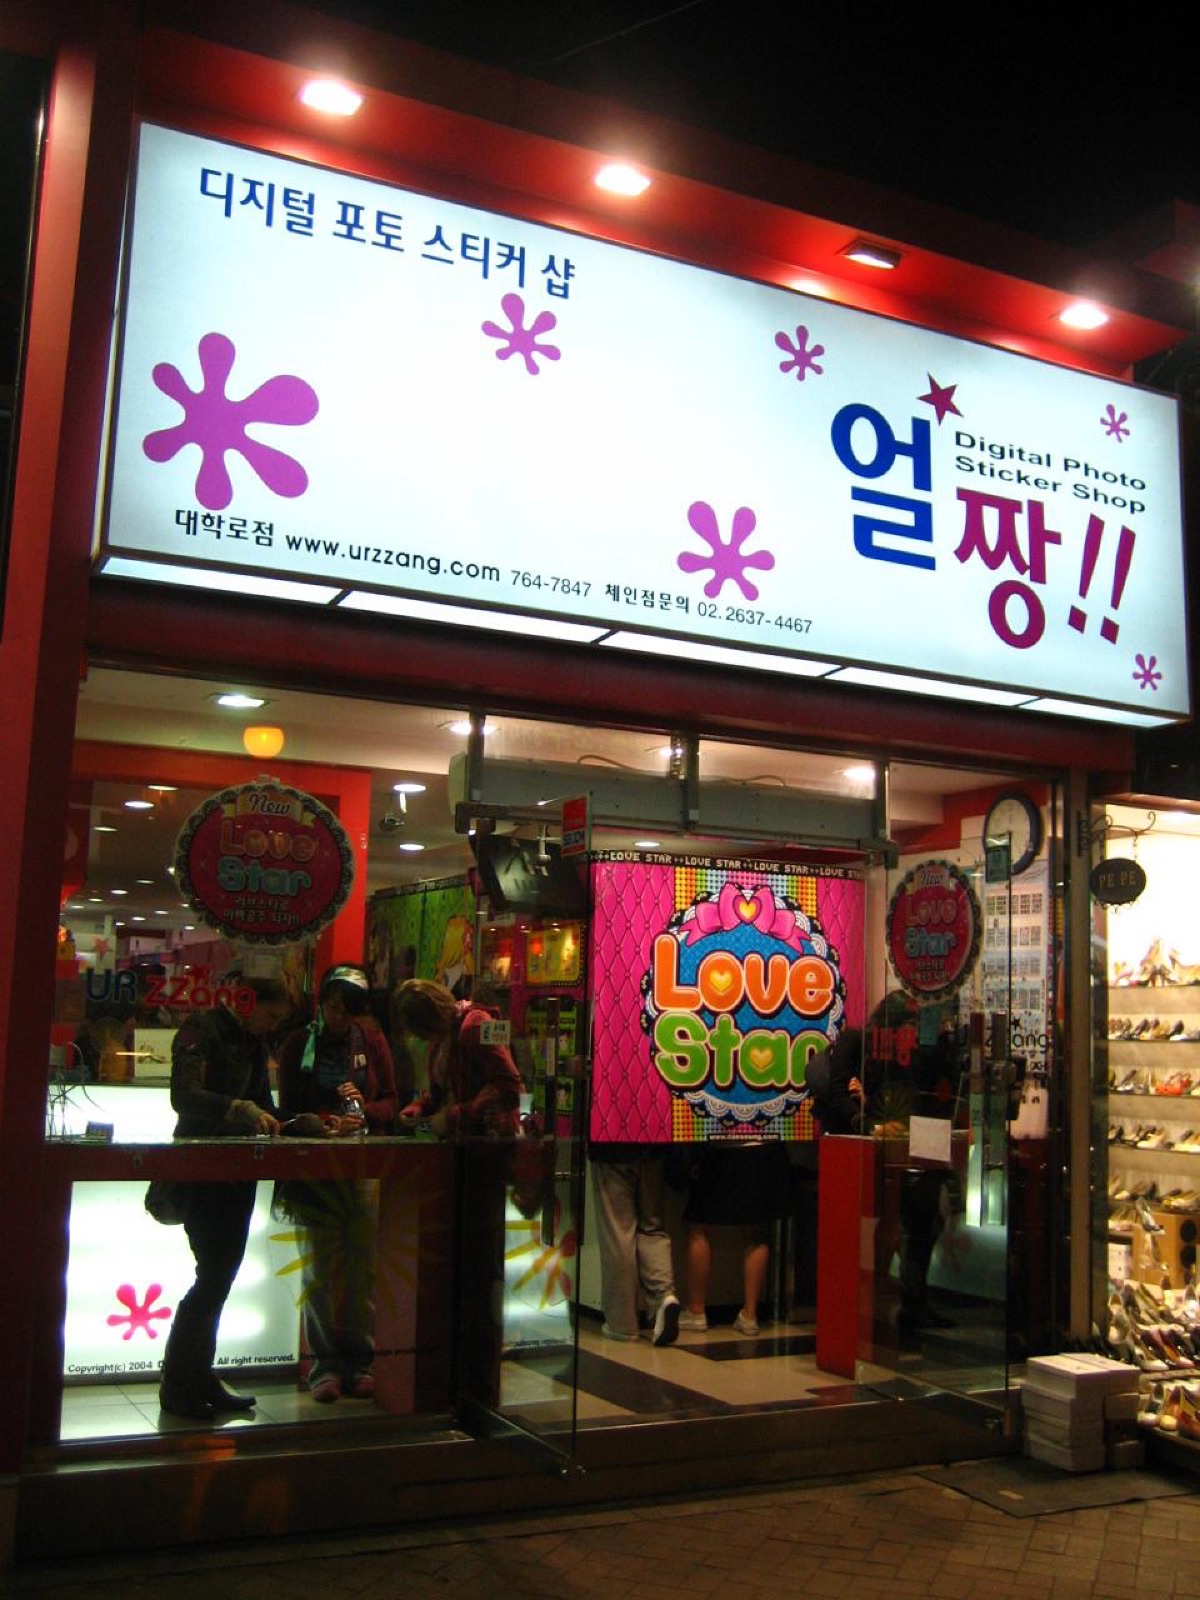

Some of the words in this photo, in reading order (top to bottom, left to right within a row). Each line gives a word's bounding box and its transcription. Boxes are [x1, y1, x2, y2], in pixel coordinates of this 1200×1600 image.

[200, 167, 316, 237] 디지털
[333, 200, 404, 254] 포토
[421, 225, 526, 289] 스티커
[541, 254, 575, 299] 샵
[955, 431, 1051, 468] Digital
[1064, 457, 1146, 490] Photo
[955, 455, 1062, 492] Sticker
[1073, 483, 1146, 514] Shop
[831, 402, 1136, 649] 얼짱!!
[175, 508, 274, 547] 대학로점
[286, 532, 500, 582] www.urzzang.com
[511, 569, 592, 598] 764-7847
[605, 583, 690, 614] 체인점문의
[698, 601, 813, 634] 02.2637-4467
[248, 792, 292, 816] New
[219, 818, 318, 863] Love
[610, 852, 640, 863] LOVE
[645, 854, 672, 865] STAR
[684, 856, 711, 868] LOVE
[716, 858, 742, 870] STAR
[754, 860, 780, 872] LOVE
[785, 862, 810, 875] STAR
[820, 866, 844, 878] LOVE
[217, 854, 313, 897] Star
[652, 932, 836, 1018] Love
[651, 1009, 831, 1091] Star
[129, 1361, 153, 1371] 2004
